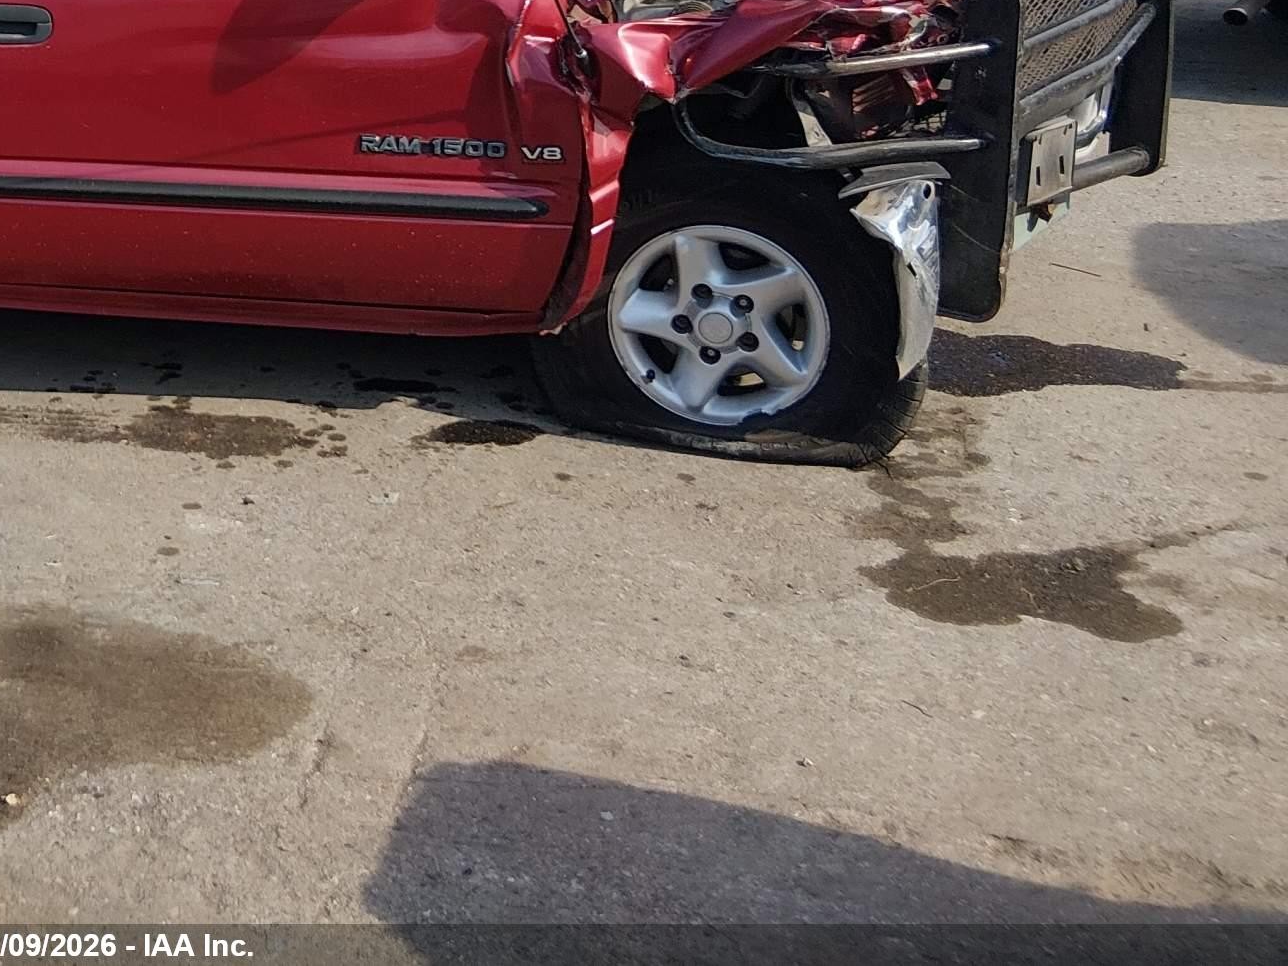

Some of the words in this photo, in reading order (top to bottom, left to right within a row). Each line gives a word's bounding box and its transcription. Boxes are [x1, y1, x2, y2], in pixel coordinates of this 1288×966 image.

[361, 134, 421, 154] RAM
[432, 137, 506, 158] 1500
[520, 146, 563, 160] V8
